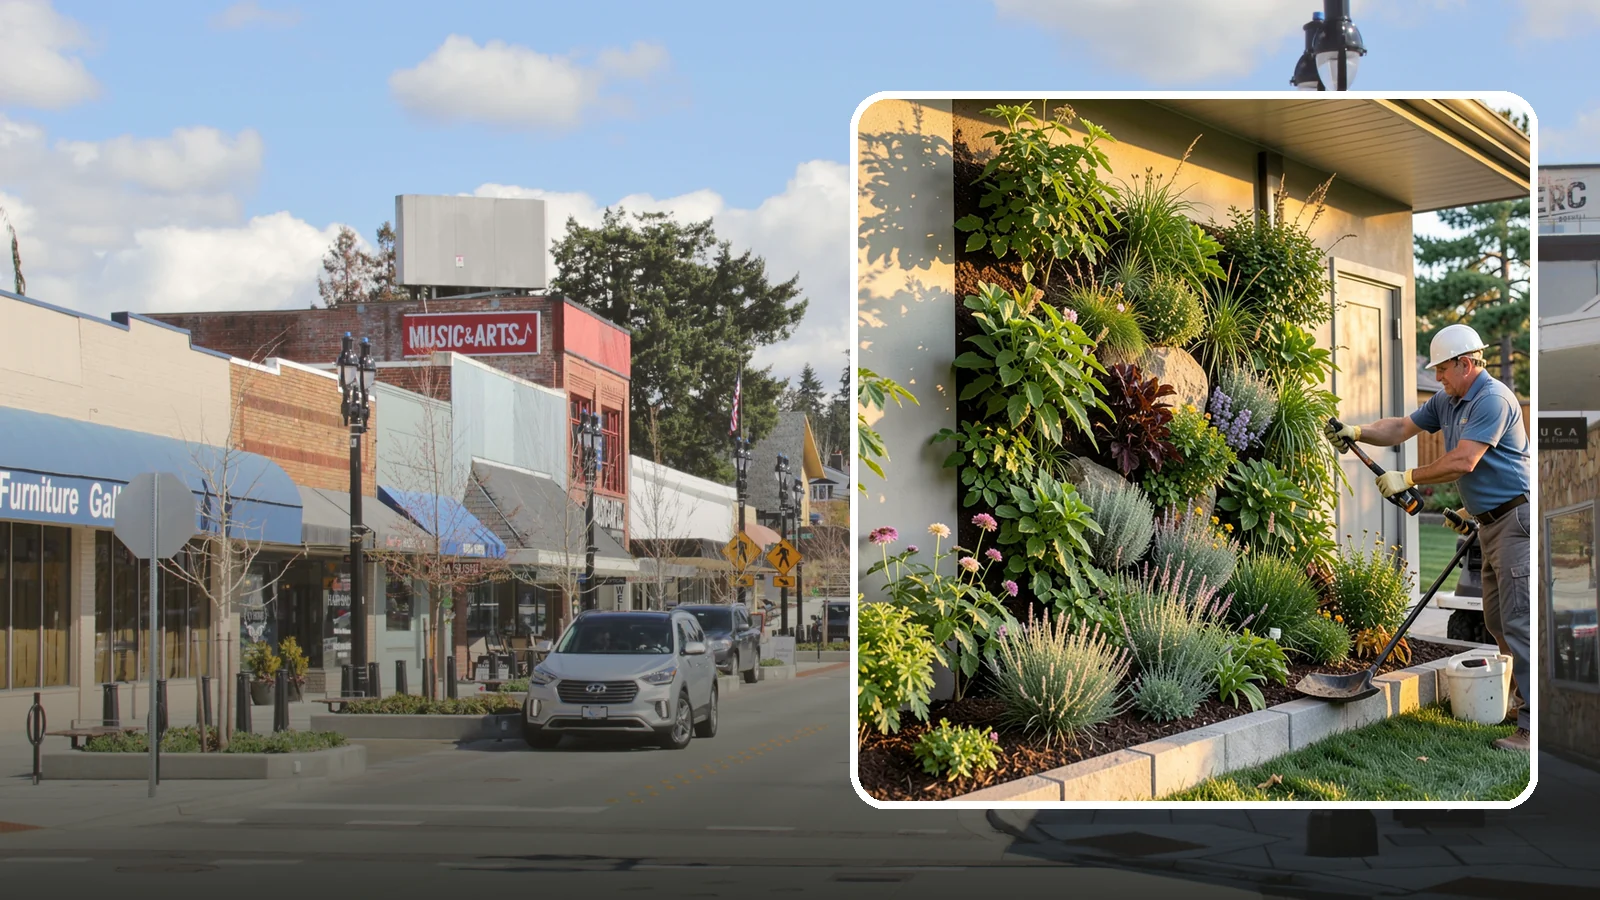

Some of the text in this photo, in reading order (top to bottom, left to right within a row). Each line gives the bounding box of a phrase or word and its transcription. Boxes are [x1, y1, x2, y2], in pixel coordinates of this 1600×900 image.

[0, 472, 122, 519] Furniture Gal
[453, 563, 479, 574] SUSHI
